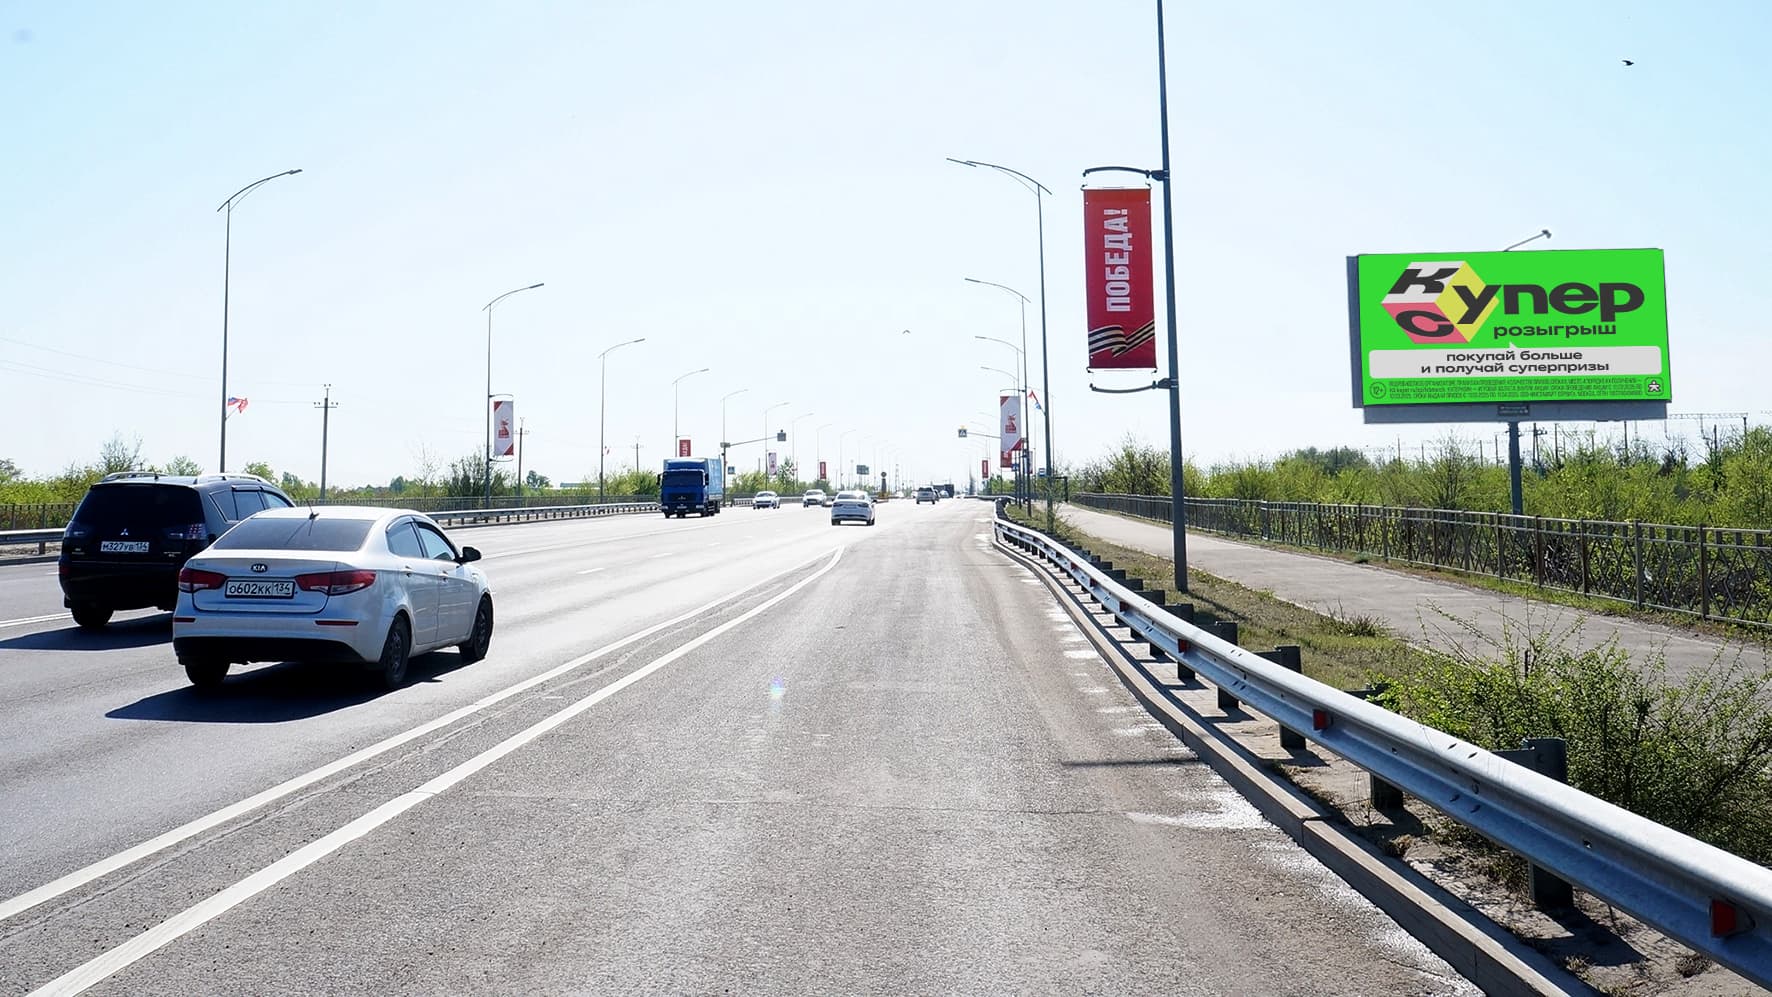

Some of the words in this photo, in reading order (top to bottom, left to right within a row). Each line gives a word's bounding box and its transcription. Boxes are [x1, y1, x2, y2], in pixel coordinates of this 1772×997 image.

[1103, 208, 1132, 312] ПОБЕДА!
[1494, 324, 1617, 339] розыгрыш
[1446, 350, 1516, 362] покупай
[1520, 349, 1583, 360] больше
[1435, 363, 1504, 375] получай
[1509, 361, 1610, 374] суперпризы
